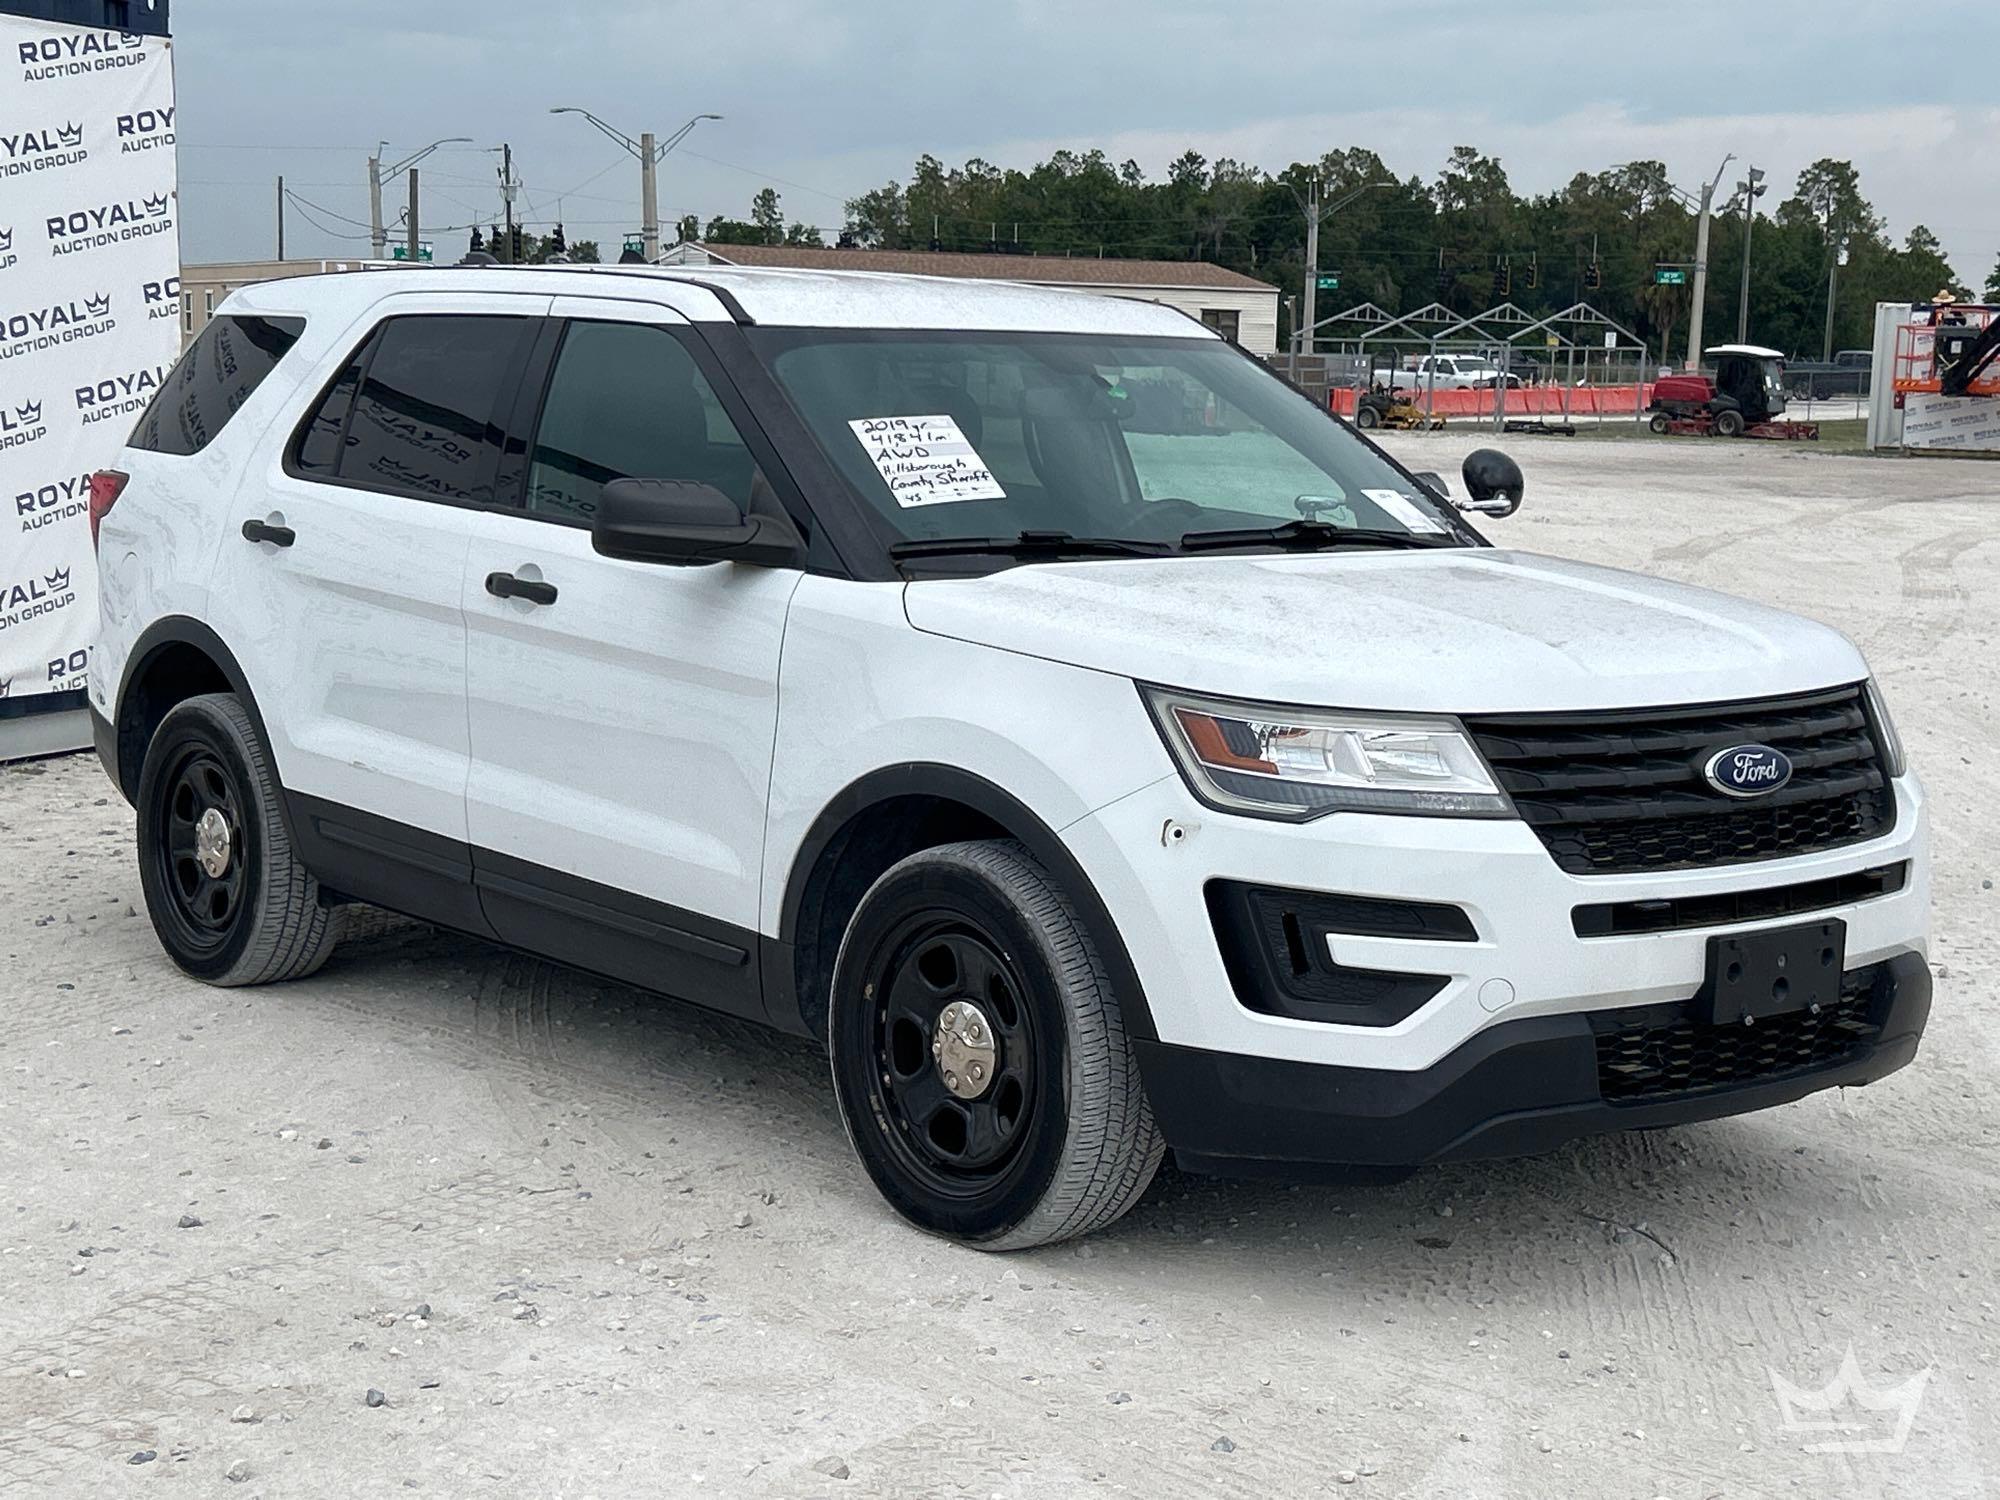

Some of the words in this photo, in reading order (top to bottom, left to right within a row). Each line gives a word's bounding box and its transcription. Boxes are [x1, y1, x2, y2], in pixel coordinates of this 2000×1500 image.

[18, 32, 118, 64] ROYAL
[24, 61, 92, 82] AUCTION
[95, 53, 146, 71] GROUP
[34, 150, 88, 171] GROUP
[47, 201, 144, 239] ROYAL
[52, 231, 118, 257] AUCTION
[121, 219, 173, 241] GROUP
[148, 303, 181, 320] AUC
[0, 333, 60, 360] UCTION
[63, 319, 116, 342] GROUP
[82, 397, 147, 426] AUCTION
[862, 420, 909, 434] 2019
[877, 446, 930, 462] AWD
[883, 458, 967, 477] Hillsborough
[16, 472, 100, 516] ROYA
[890, 475, 935, 491] County
[22, 501, 88, 533] AUCTION
[22, 592, 76, 621] GROUP
[48, 646, 93, 681] RO
[1733, 753, 1779, 784] Ford
